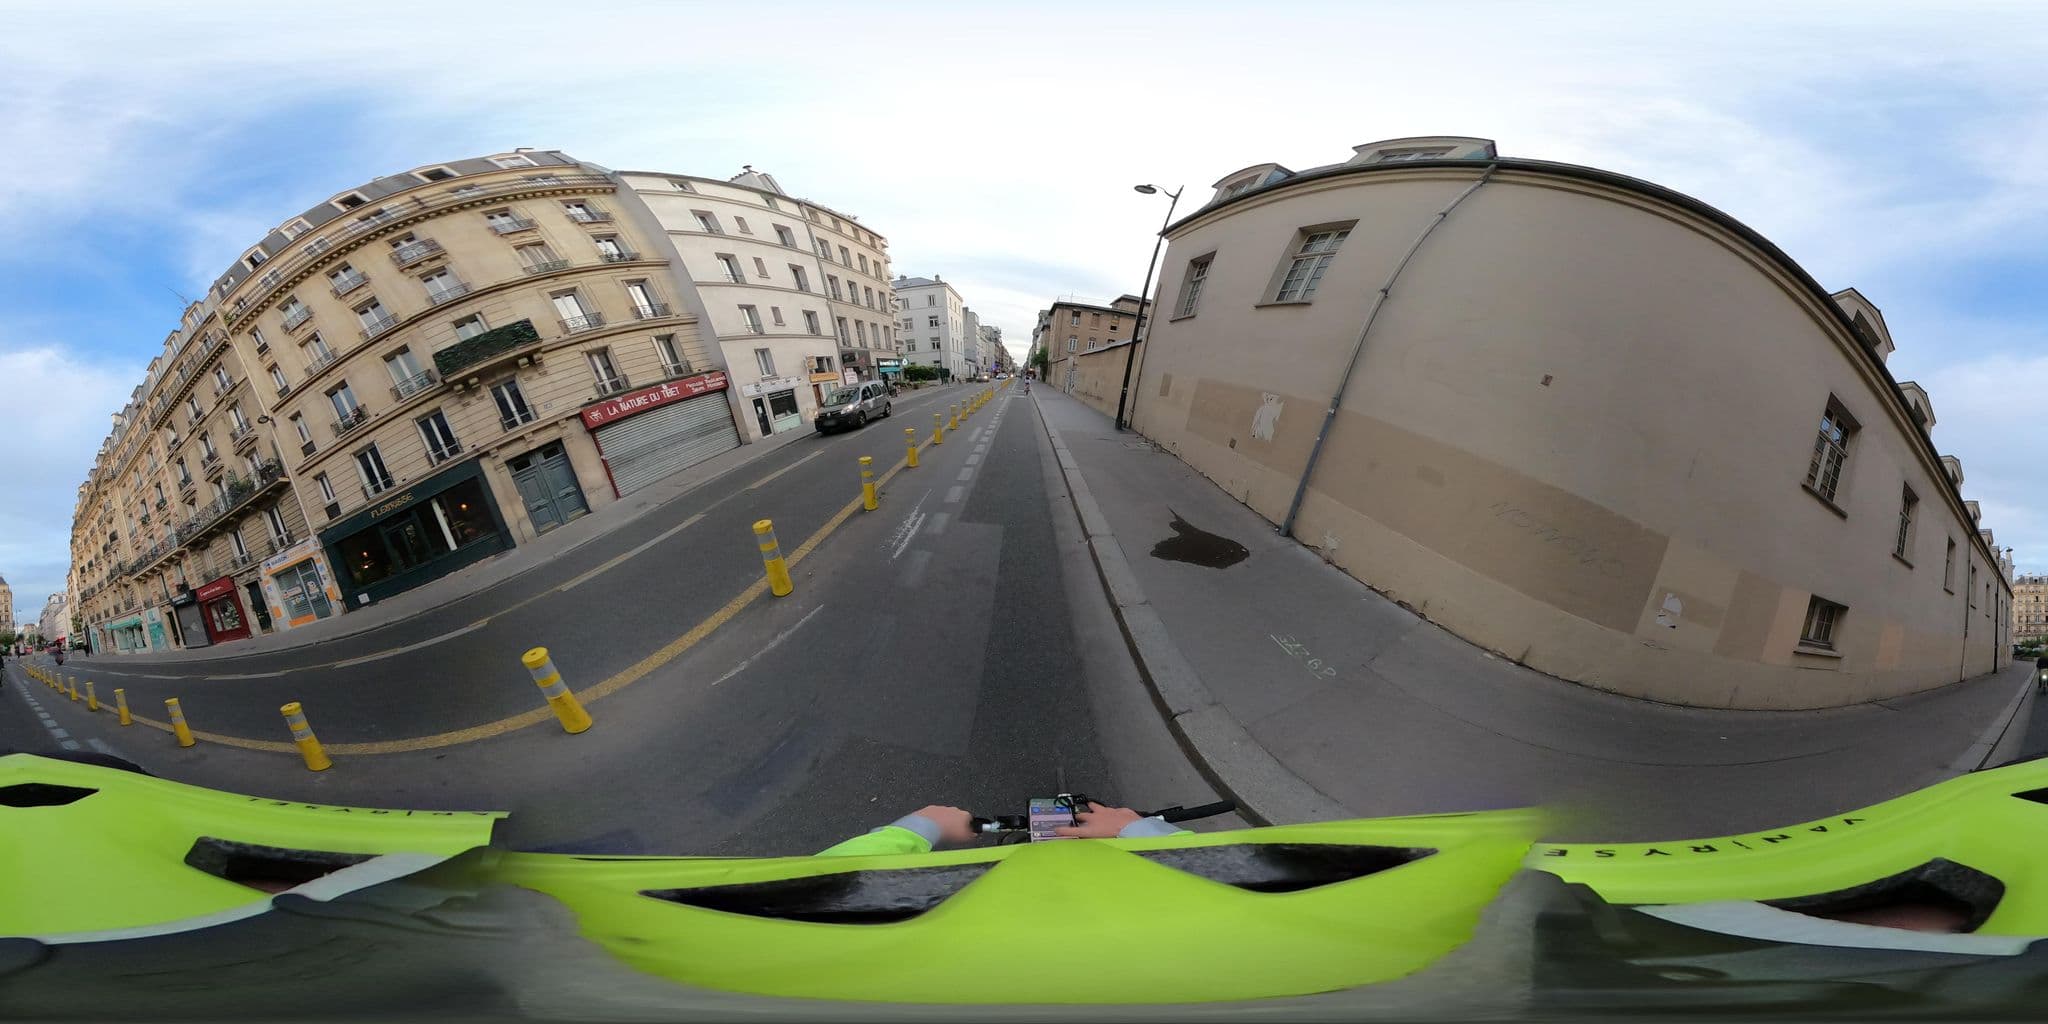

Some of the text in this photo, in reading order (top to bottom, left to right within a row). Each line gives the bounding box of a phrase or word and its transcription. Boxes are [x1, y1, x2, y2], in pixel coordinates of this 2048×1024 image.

[607, 407, 619, 416] LA
[620, 396, 649, 411] NATURE
[649, 393, 661, 402] DU
